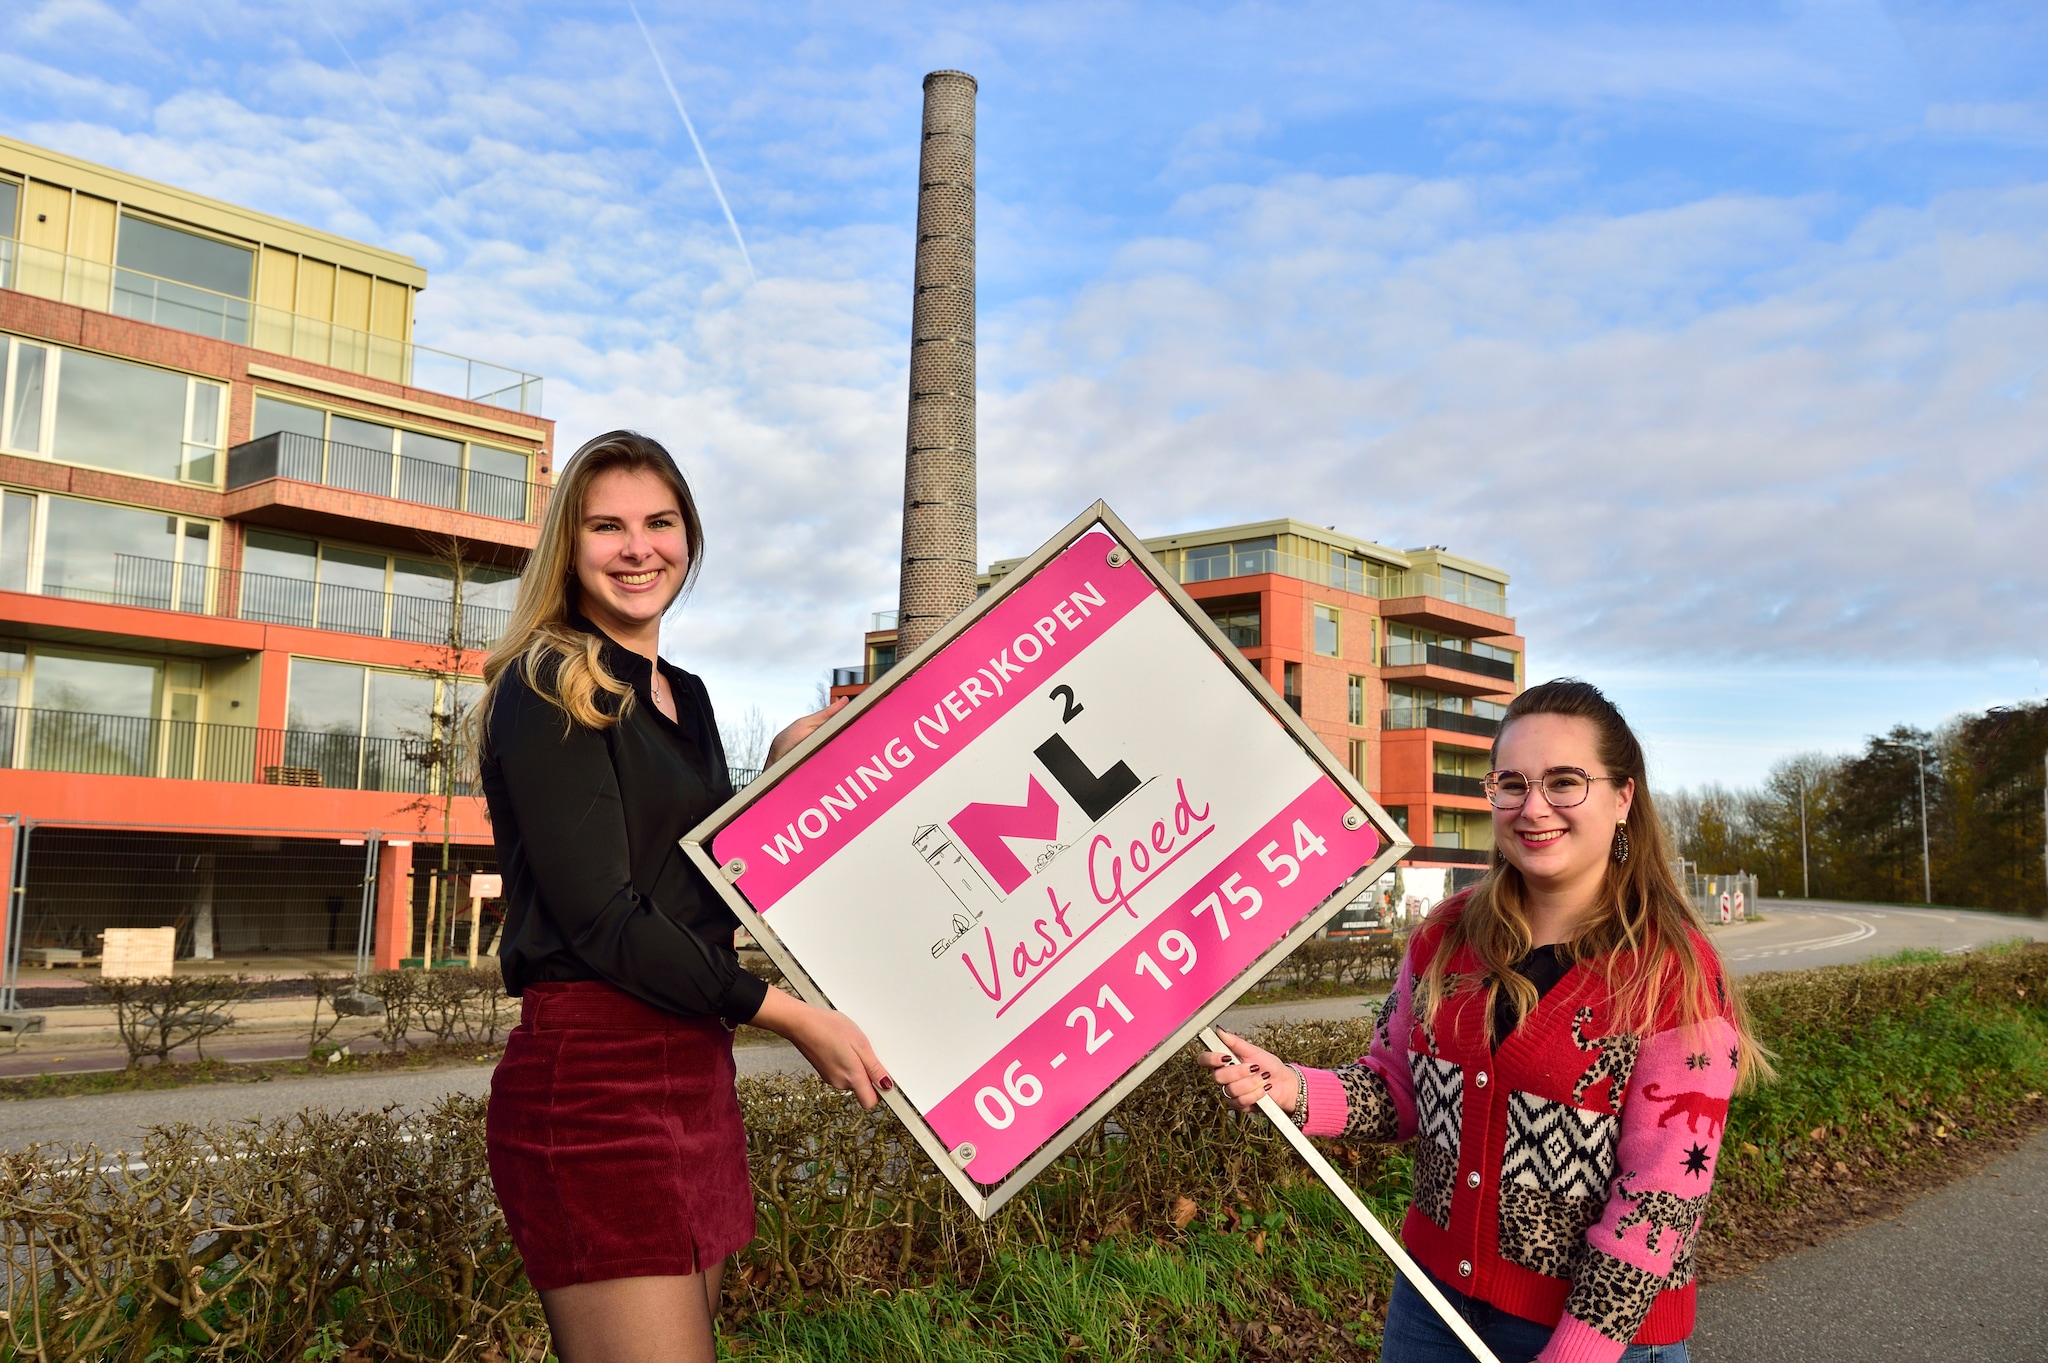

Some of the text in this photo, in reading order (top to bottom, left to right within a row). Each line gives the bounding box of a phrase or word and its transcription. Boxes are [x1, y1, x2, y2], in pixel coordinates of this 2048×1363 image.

[761, 581, 1107, 865] WONING (VER)KOPEN
[962, 777, 1211, 1002] Vast Goed
[974, 818, 1328, 1130] 06 - 21 19 75 54
